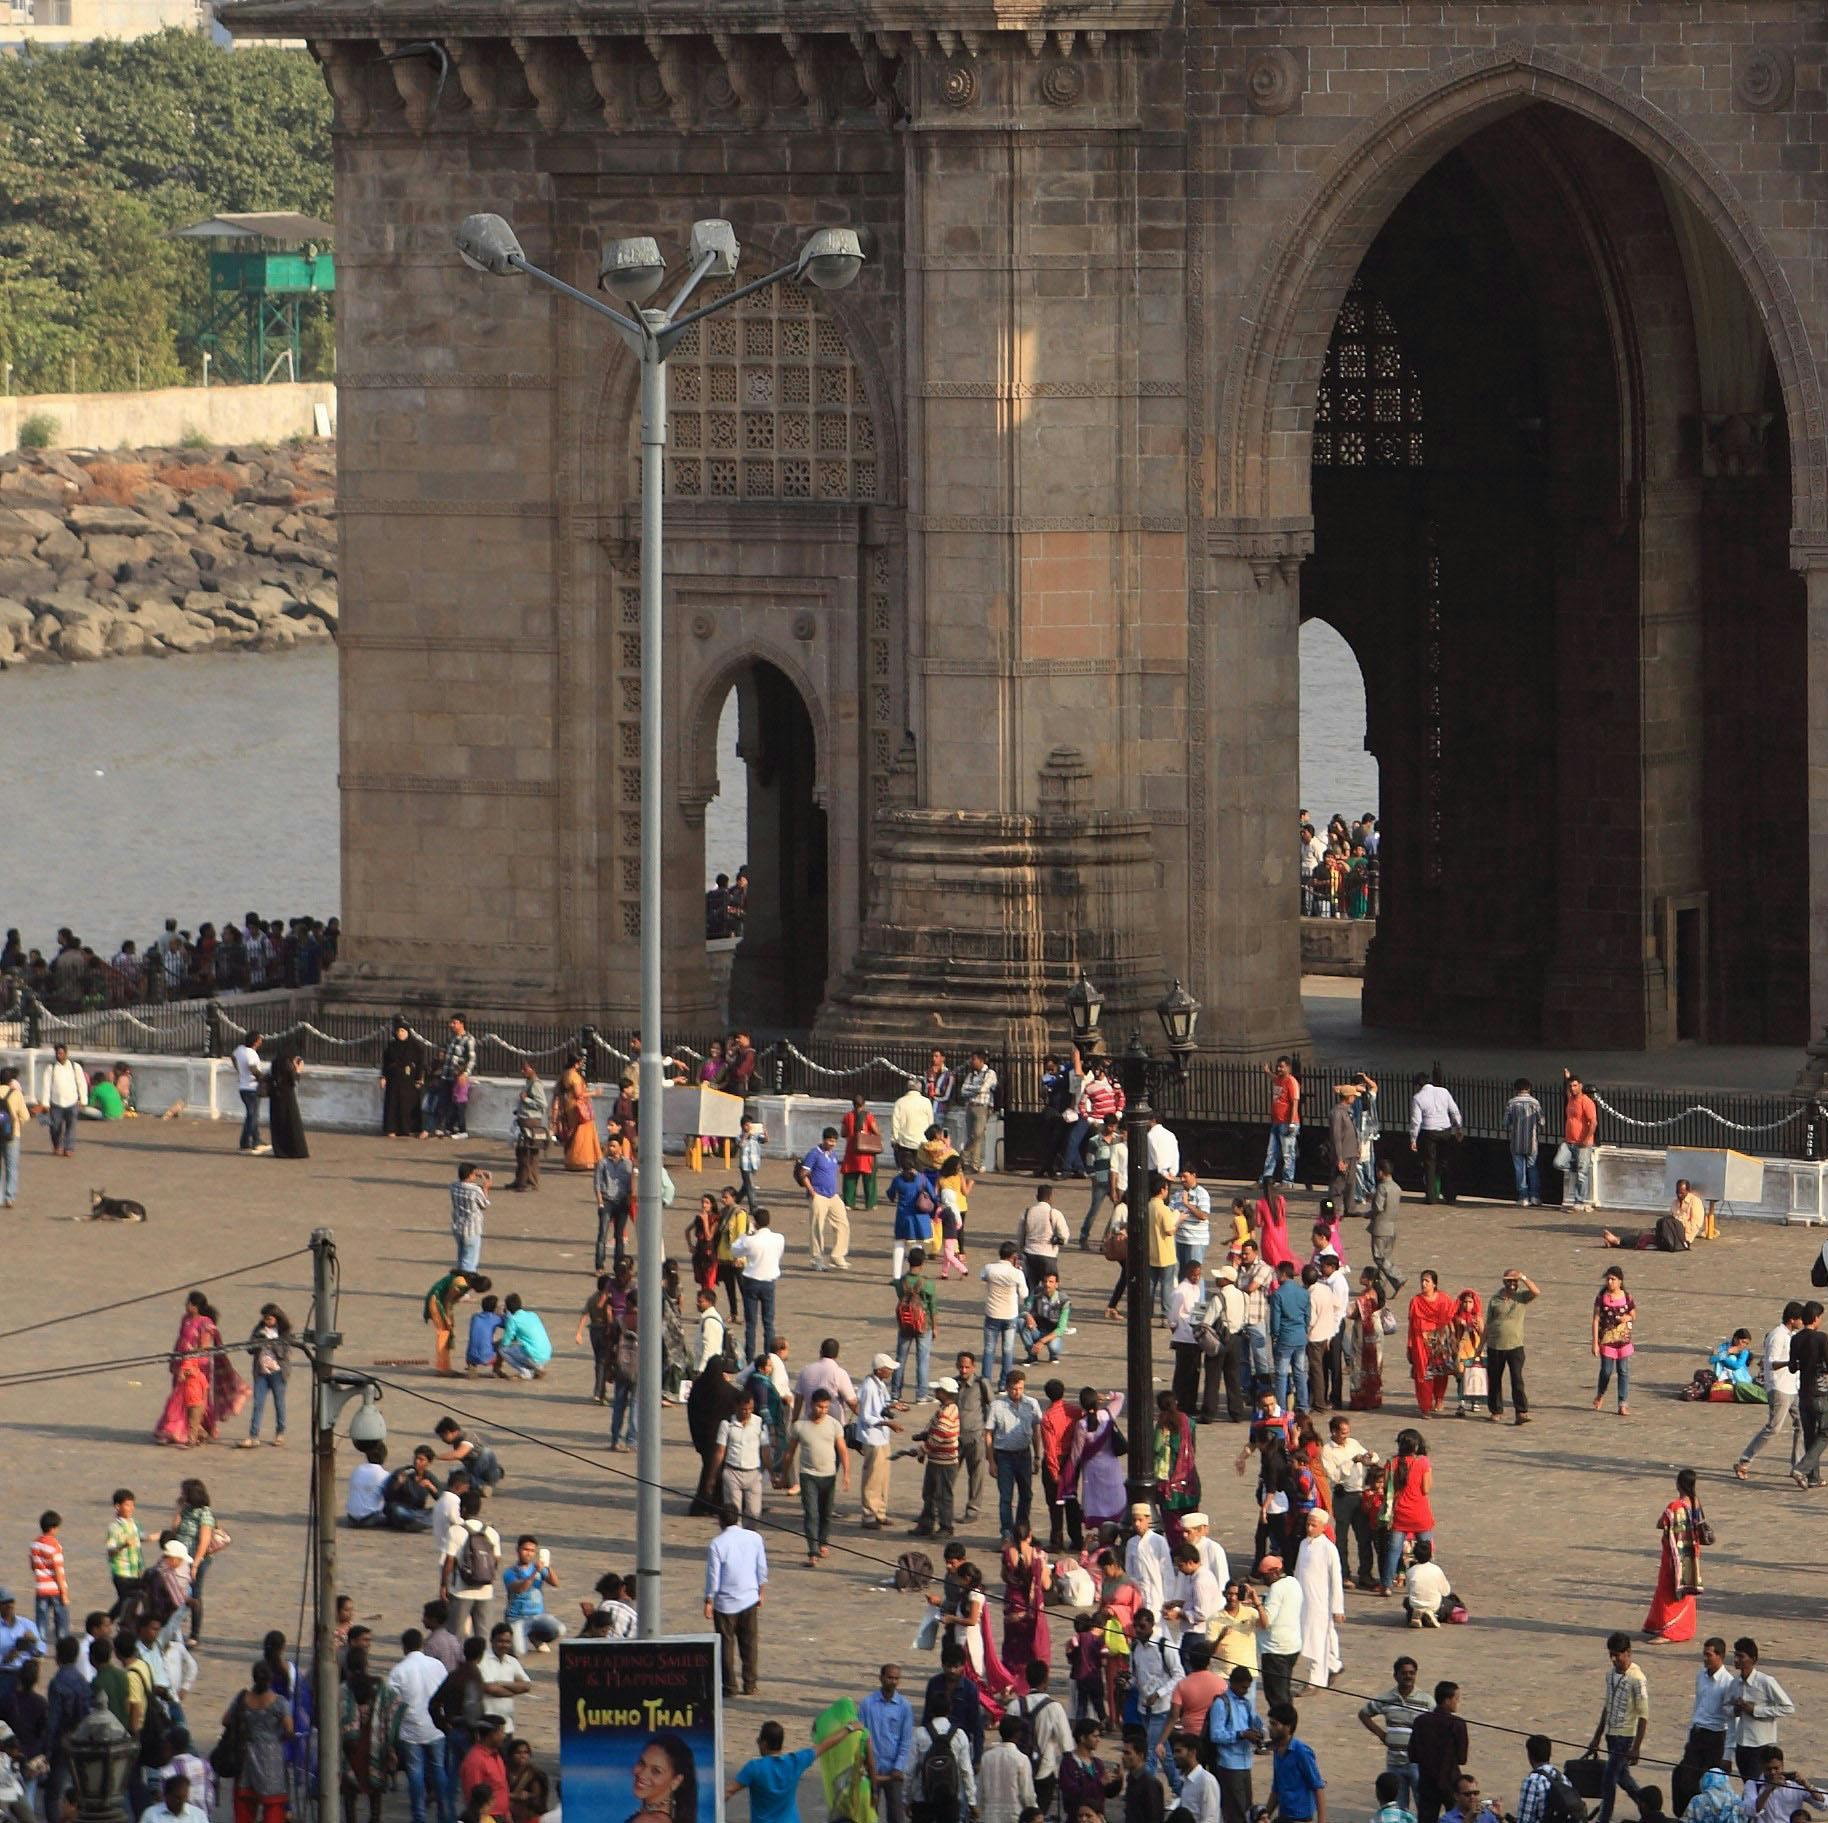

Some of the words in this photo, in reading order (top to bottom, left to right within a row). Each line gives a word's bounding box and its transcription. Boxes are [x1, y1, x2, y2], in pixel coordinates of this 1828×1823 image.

[565, 1653, 653, 1669] SPREADING
[658, 1652, 711, 1668] SMILES
[586, 1674, 599, 1686] &
[605, 1670, 688, 1688] HAPPINESS
[576, 1697, 641, 1732] SUKHO
